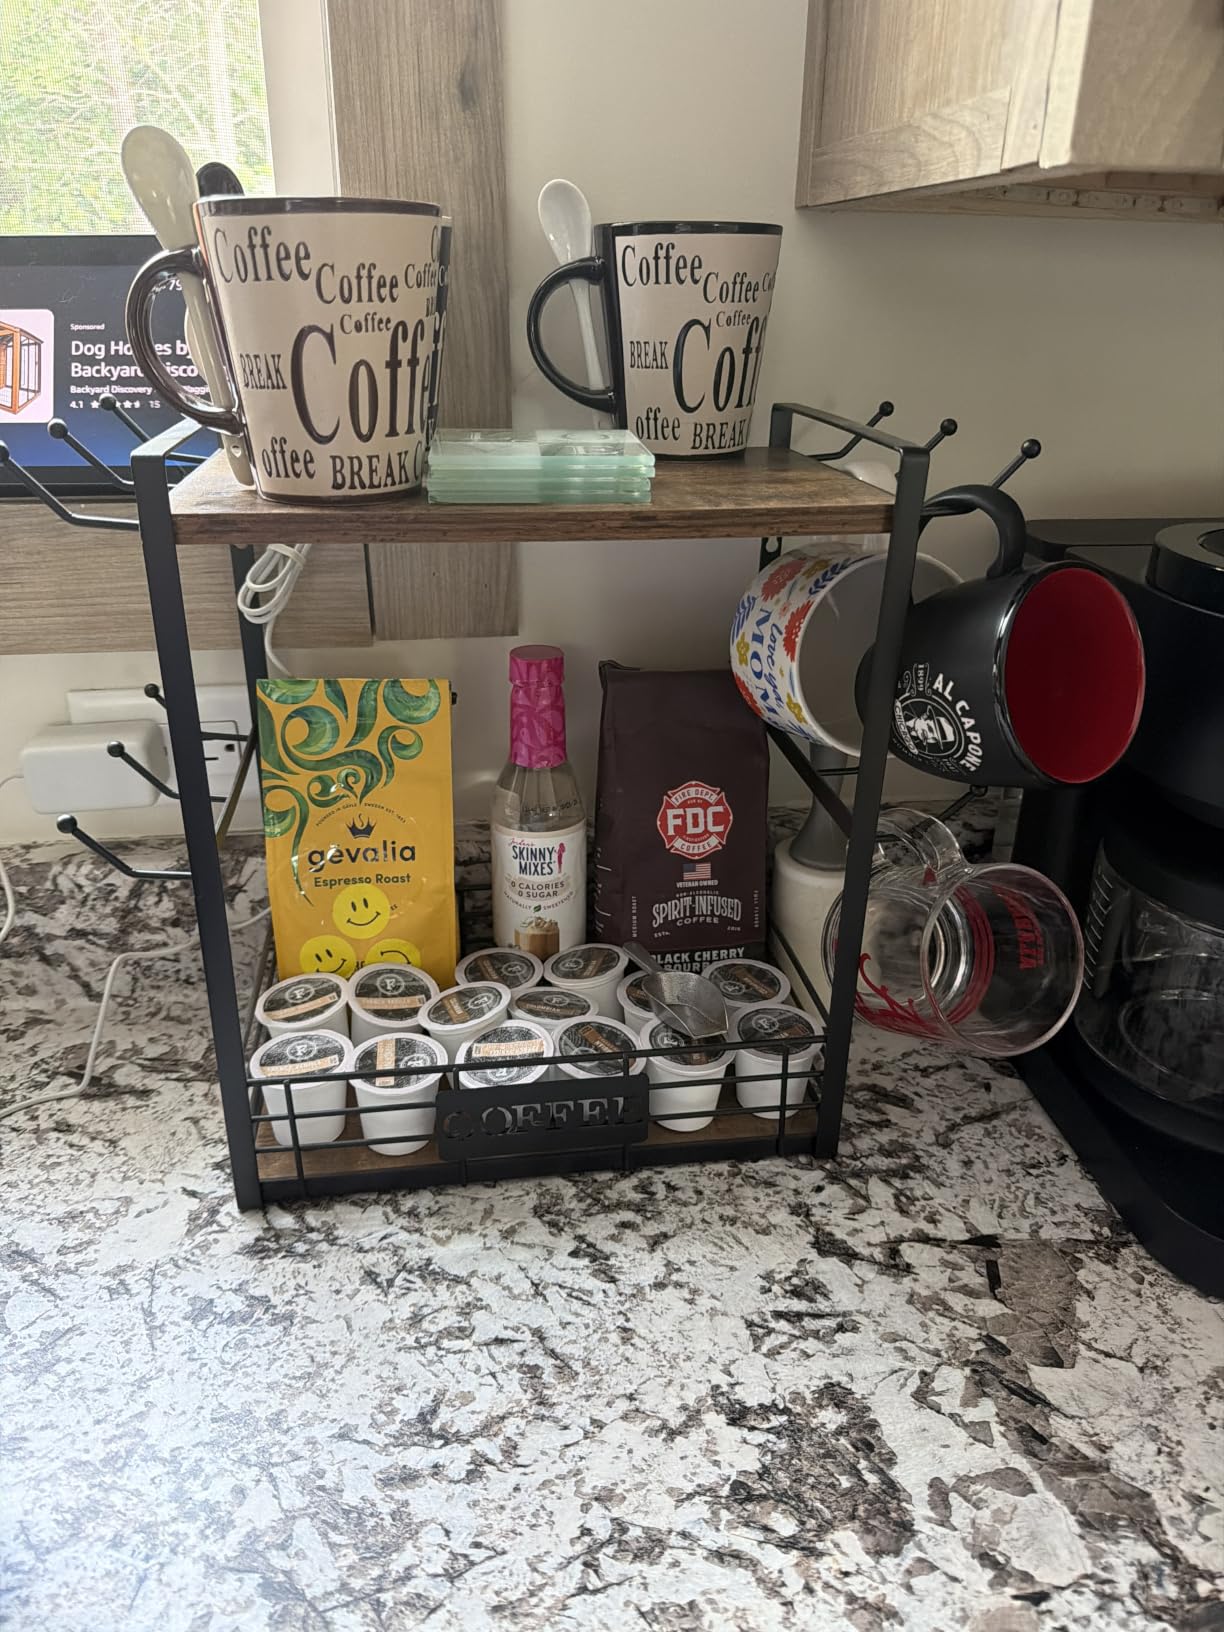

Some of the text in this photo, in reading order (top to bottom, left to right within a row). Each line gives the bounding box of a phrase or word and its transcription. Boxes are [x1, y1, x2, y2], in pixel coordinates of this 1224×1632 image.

[213, 225, 312, 285] Coffee
[621, 242, 703, 288] Coffee
[315, 261, 399, 305] Coffee
[702, 271, 760, 304] Coffee
[69, 322, 106, 332] Sponsored
[339, 312, 393, 335] Coffee
[716, 310, 751, 328] Coffee
[70, 340, 106, 359] Dog
[110, 340, 173, 356] Hoes
[629, 340, 669, 370] BREAK
[239, 352, 288, 391] BREAK
[672, 315, 769, 415] Coff
[69, 384, 110, 396] Backyard
[110, 384, 153, 397] Discovery
[69, 400, 84, 409] 4.1
[635, 406, 681, 441] offee
[690, 418, 747, 451] BREAK
[261, 436, 317, 480] offee
[329, 450, 410, 491] BREAK
[931, 672, 984, 772] AL CAPONE
[674, 787, 714, 804] FIRE DEPT.
[665, 805, 725, 836] FDC
[511, 845, 556, 862] SKINNY
[680, 841, 712, 852] COFFEE
[518, 861, 555, 877] MIXES
[313, 873, 412, 889] Espresso Roast
[510, 880, 566, 891] 0 CALORIES
[676, 879, 719, 889] VETERAN OWNED
[503, 891, 532, 911] NATURALLY
[517, 889, 559, 899] 0 SUGAR
[652, 894, 743, 928] SPIRIT-INFUSED
[675, 915, 720, 927] COFFEE
[694, 946, 746, 962] CHERRY
